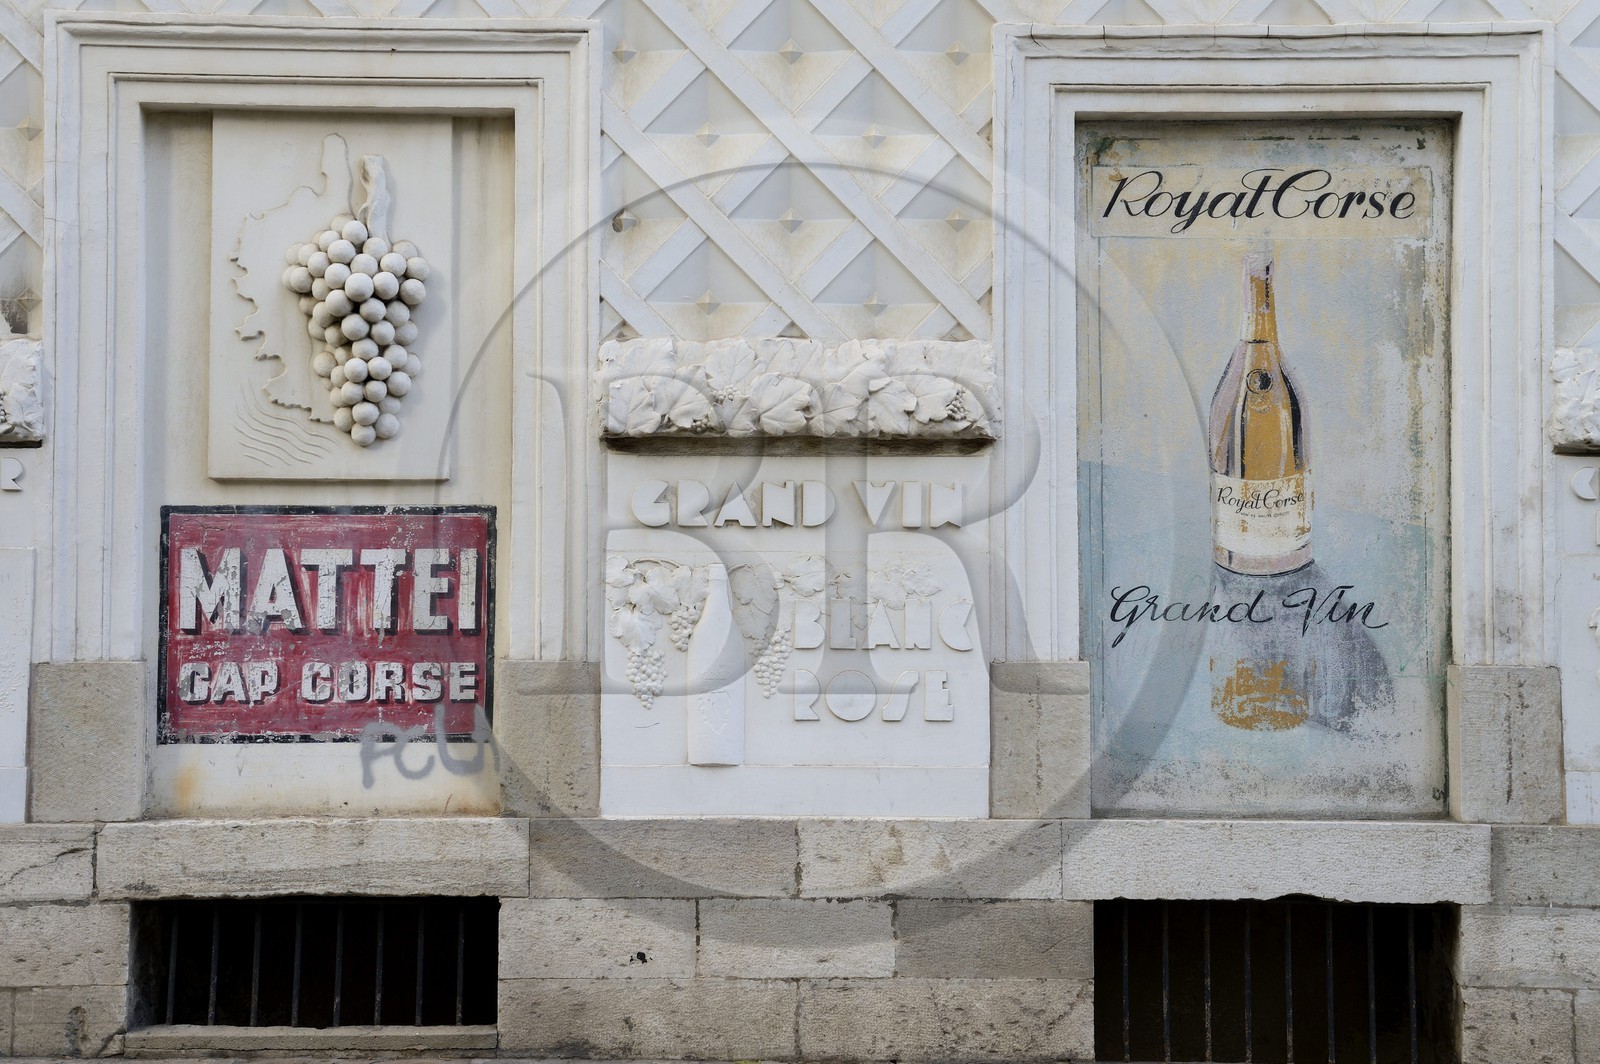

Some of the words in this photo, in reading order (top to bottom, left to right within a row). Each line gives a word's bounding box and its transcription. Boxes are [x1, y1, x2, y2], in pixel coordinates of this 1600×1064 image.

[1272, 169, 1416, 219] Corse
[630, 479, 837, 528] GRAND
[852, 479, 963, 528] VIN
[1263, 489, 1304, 509] Corse
[179, 546, 481, 636] MATTEI
[1110, 585, 1273, 648] Grand
[1281, 585, 1388, 637] Vin
[793, 598, 974, 652] BLANC
[178, 661, 280, 705] CAP
[301, 661, 480, 705] CORSE
[793, 668, 954, 722] ROSE
